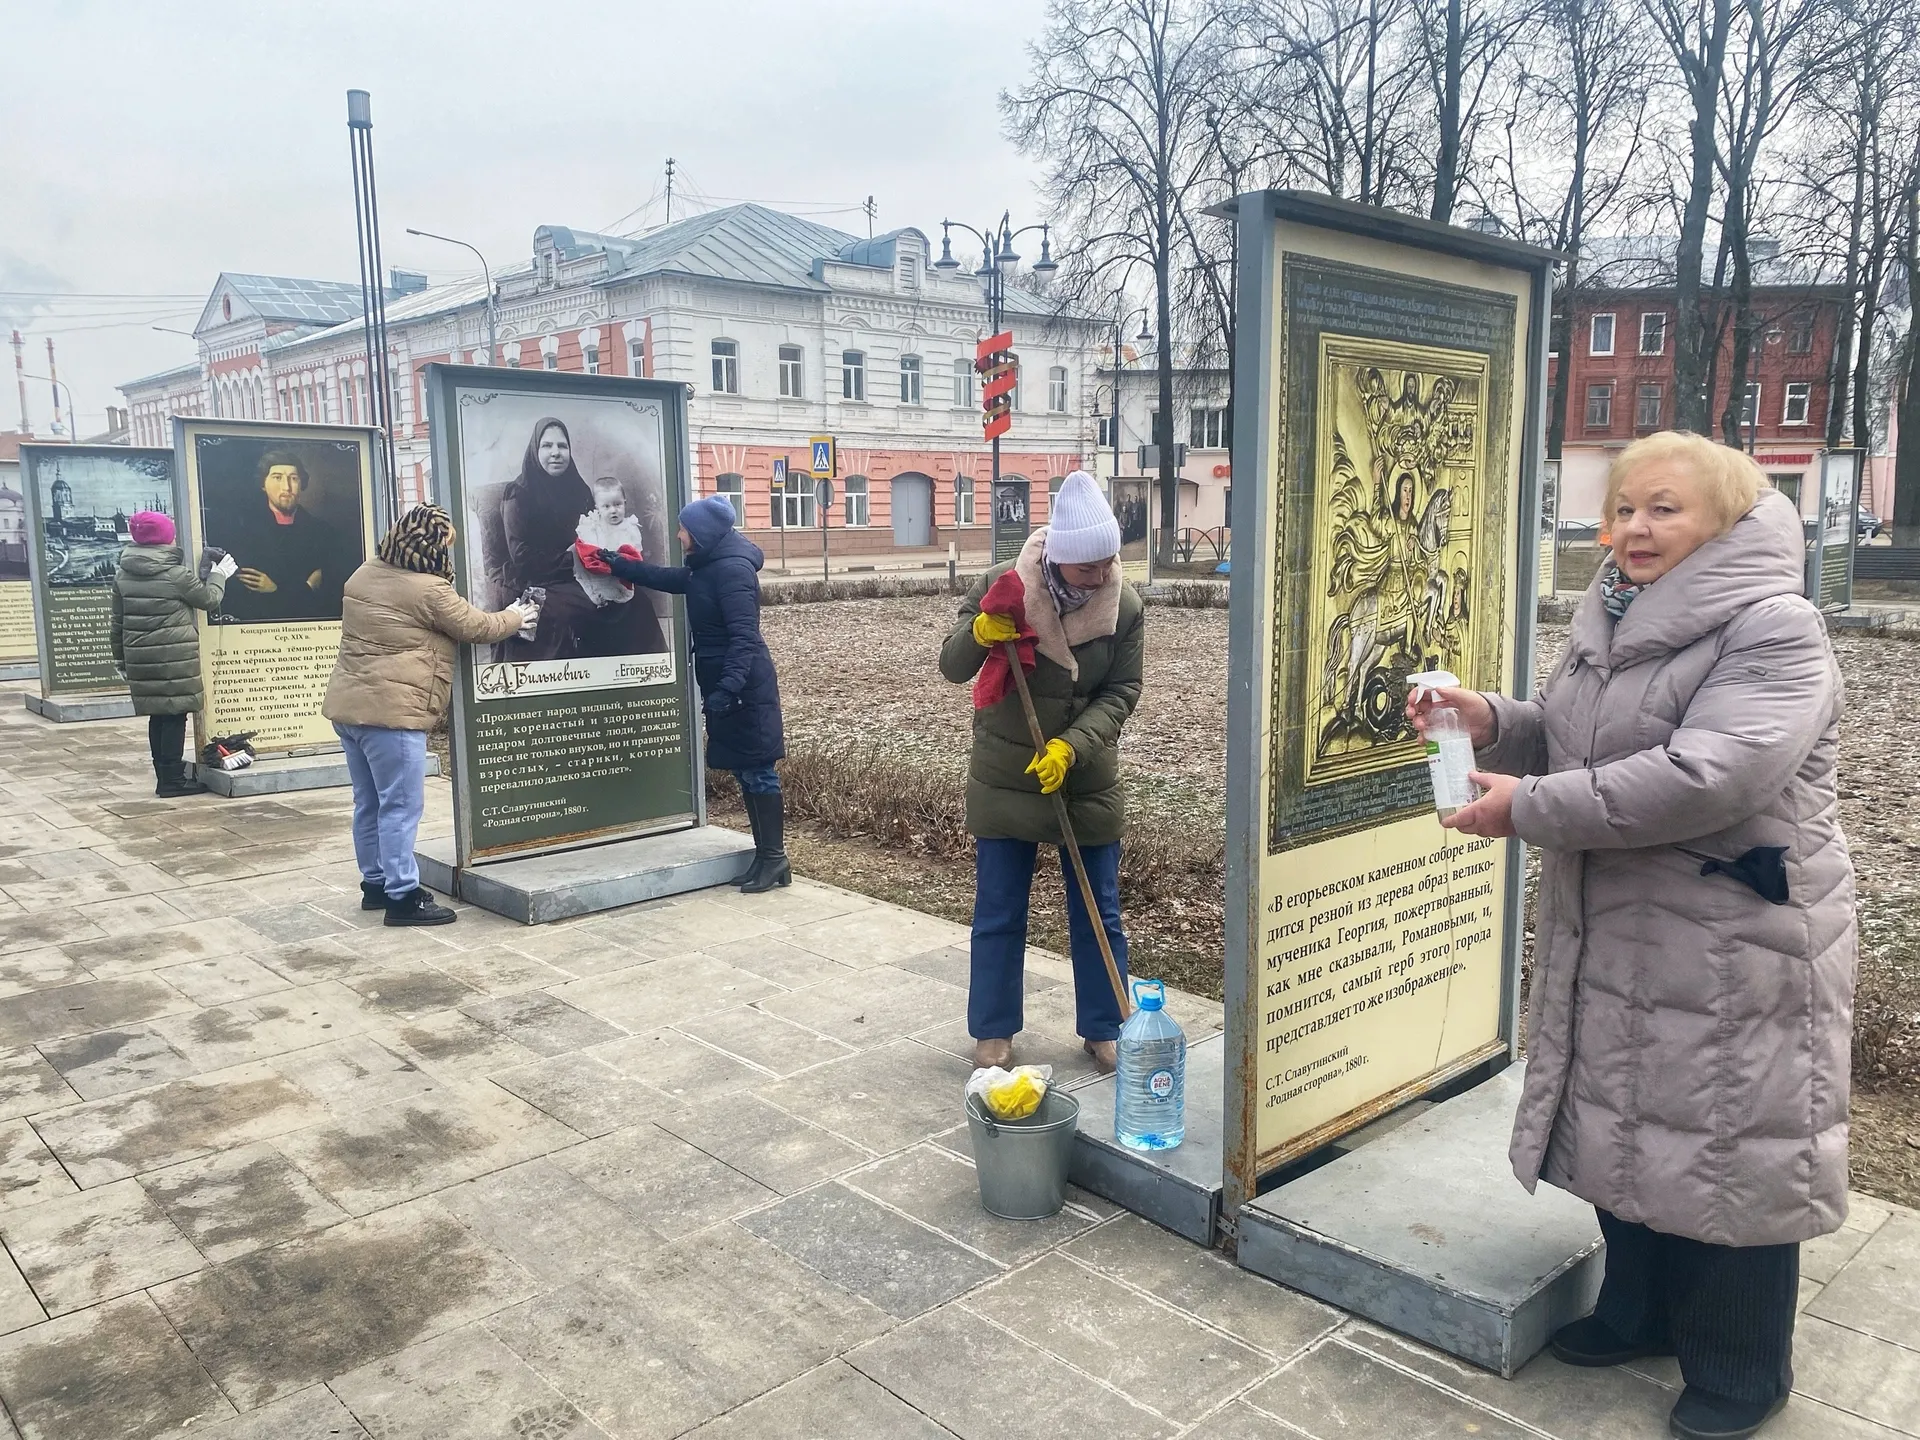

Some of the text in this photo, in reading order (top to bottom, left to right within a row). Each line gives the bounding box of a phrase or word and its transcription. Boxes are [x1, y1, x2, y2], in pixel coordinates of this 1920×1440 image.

[476, 697, 679, 725] «Проживает народ видный, высокорос-
[477, 727, 506, 738] лый,
[514, 718, 584, 735] коренастый
[604, 708, 679, 724] здоровенный;
[478, 722, 680, 751] недаром долговечные люди, дождав-
[479, 755, 513, 765] шиеся
[530, 748, 566, 758] только
[569, 744, 606, 755] внуков,
[609, 741, 620, 749] но
[632, 734, 680, 748] правнуков
[480, 764, 548, 780] взрослых,
[568, 755, 623, 767] старики,
[630, 746, 681, 759] которым
[481, 778, 544, 794] перевалило
[545, 773, 580, 785] далеко
[592, 769, 607, 777] сто
[482, 797, 566, 816] С.Т. Славутинский
[483, 817, 520, 827] «Родная
[521, 811, 563, 822] сторона»,
[564, 805, 581, 815] 1880
[1268, 836, 1495, 913] «В егорьевском каменном соборе нахо-
[1266, 861, 1494, 942] дится резной из дерева образ велико-
[1267, 881, 1493, 971] мученика Георгия, пожертвованный,
[1267, 906, 1492, 998] как мне сказывали, Романовыми, и,
[1267, 928, 1491, 1025] помнится, самый герб этого города
[1266, 963, 1466, 1052] представляет то же изображение».
[1266, 1045, 1348, 1090] С.Т. Славутинский
[1266, 1055, 1369, 1108] «Родная сторона», 1880 г.
